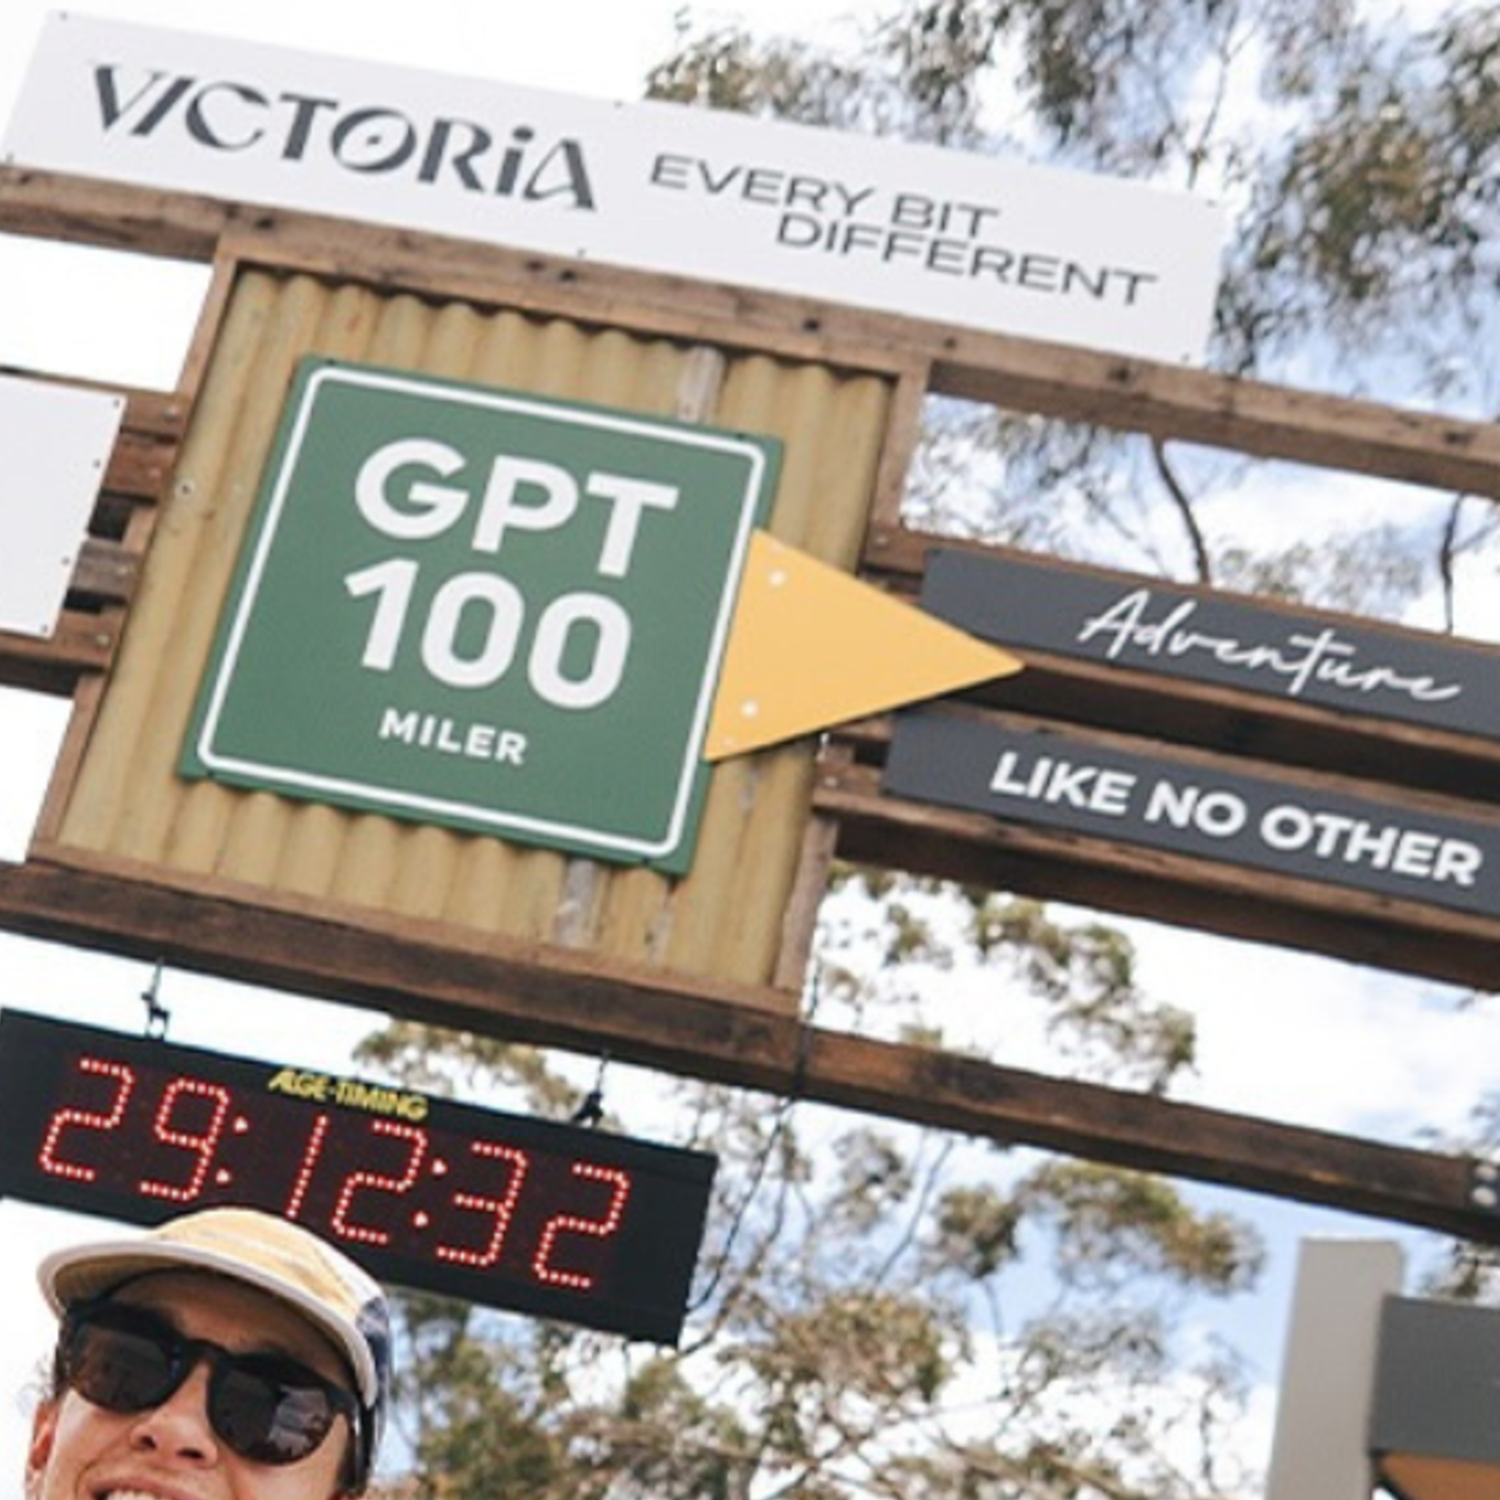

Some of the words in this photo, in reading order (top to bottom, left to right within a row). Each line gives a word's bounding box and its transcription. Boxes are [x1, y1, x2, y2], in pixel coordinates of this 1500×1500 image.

[650, 152, 877, 213] EVERY
[889, 194, 1000, 238] BIT
[775, 212, 1158, 306] DIFFERENT
[354, 438, 680, 577] GPT
[344, 557, 632, 709] 100
[1077, 590, 1462, 700] Adventure
[378, 708, 528, 766] MILER
[989, 752, 1136, 814] LIKE
[1144, 781, 1246, 836] NO
[1260, 806, 1484, 887] OTHER
[266, 1066, 429, 1121] ALGE-TIMING
[39, 1057, 630, 1288] 29:12:32
